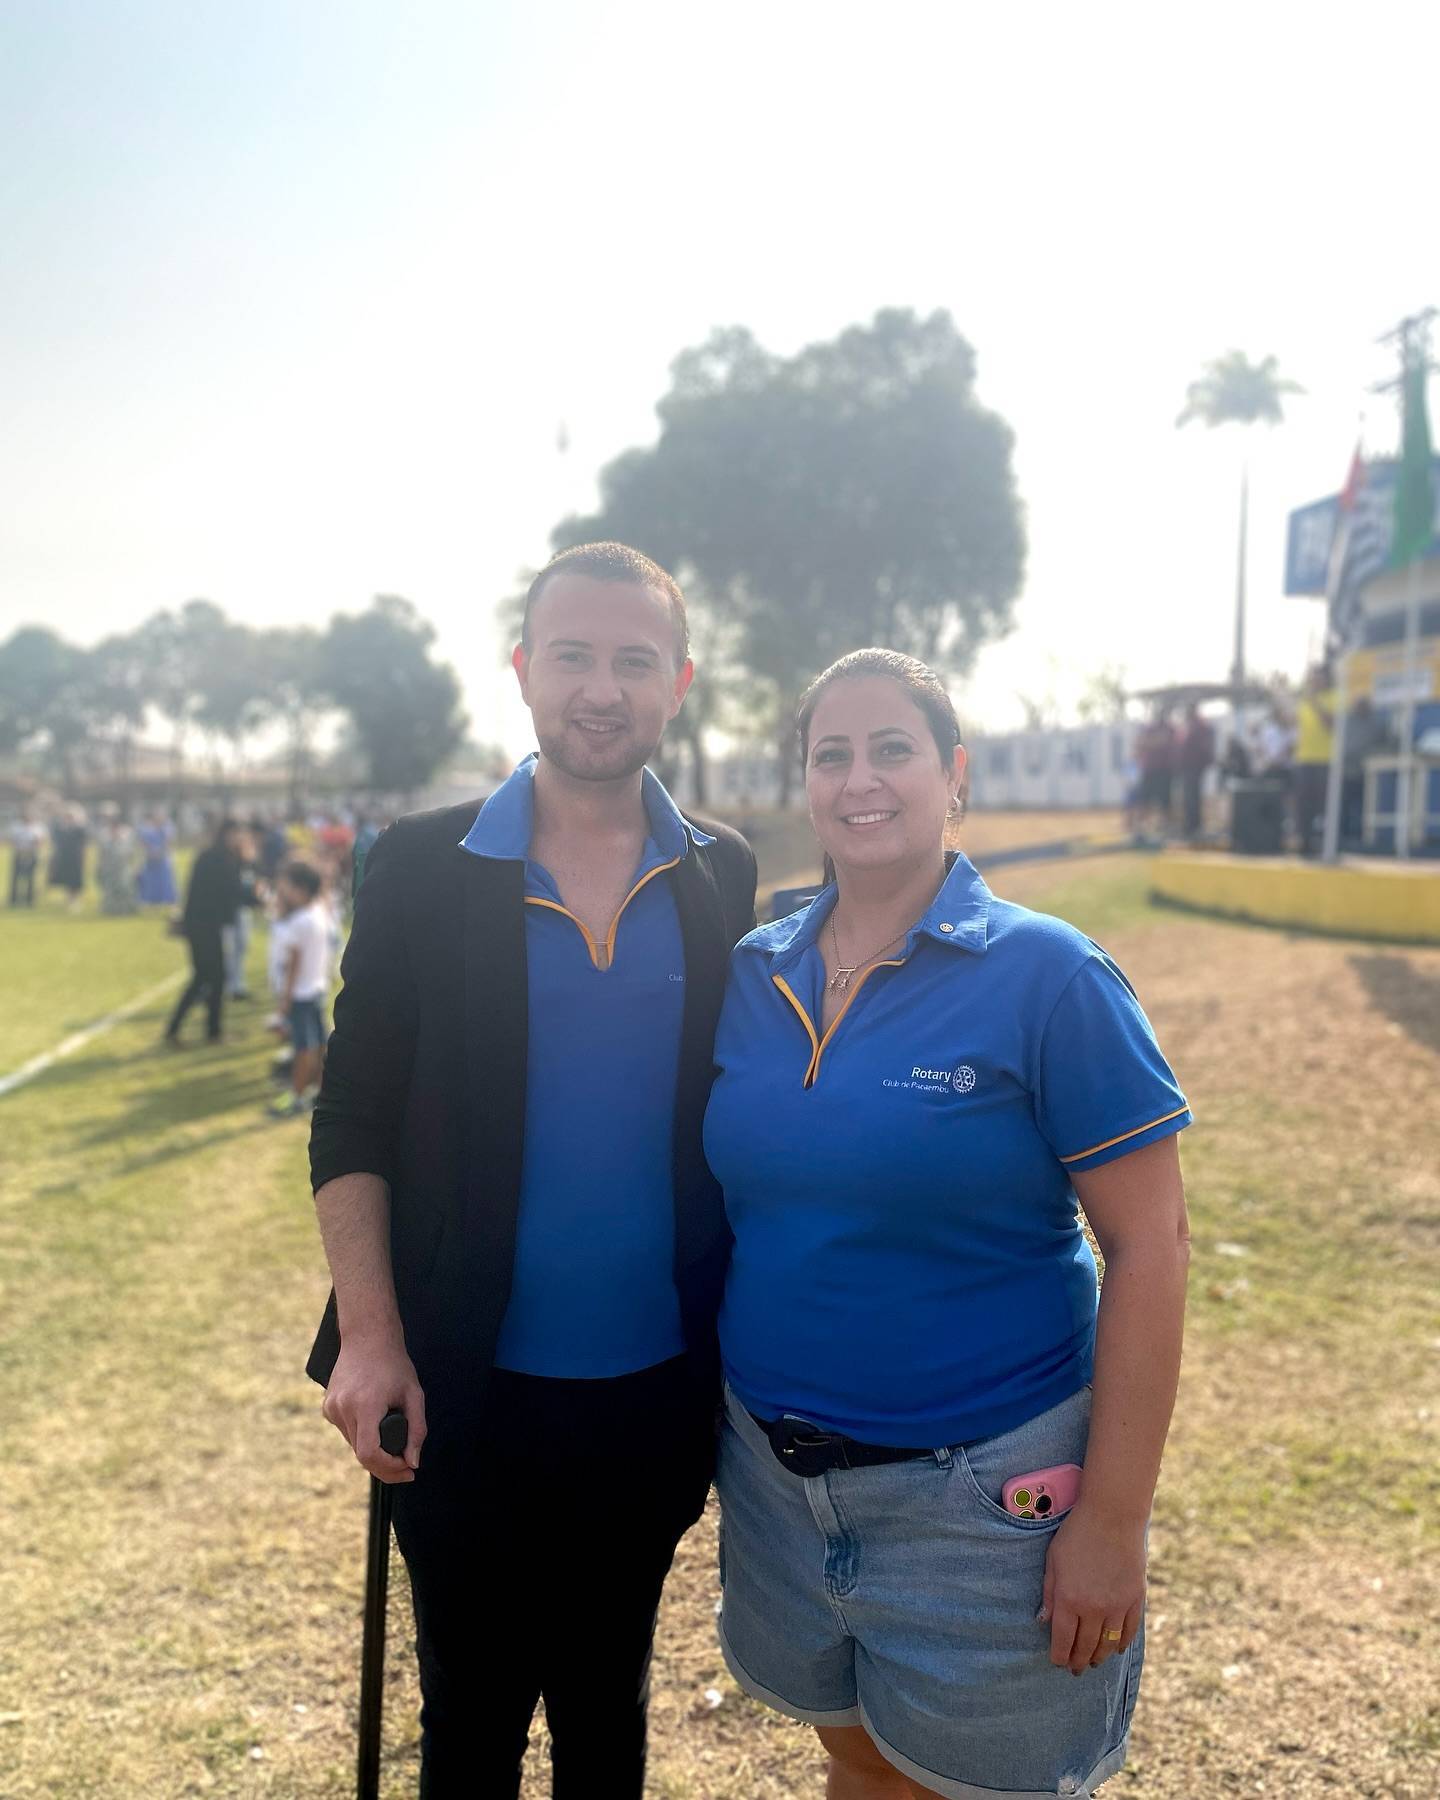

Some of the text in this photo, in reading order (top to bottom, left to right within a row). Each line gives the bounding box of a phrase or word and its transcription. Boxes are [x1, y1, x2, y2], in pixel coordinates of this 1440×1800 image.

[668, 972, 684, 981] Club
[912, 1067, 951, 1083] Rotary
[882, 1079, 900, 1087] Club
[901, 1080, 910, 1088] de
